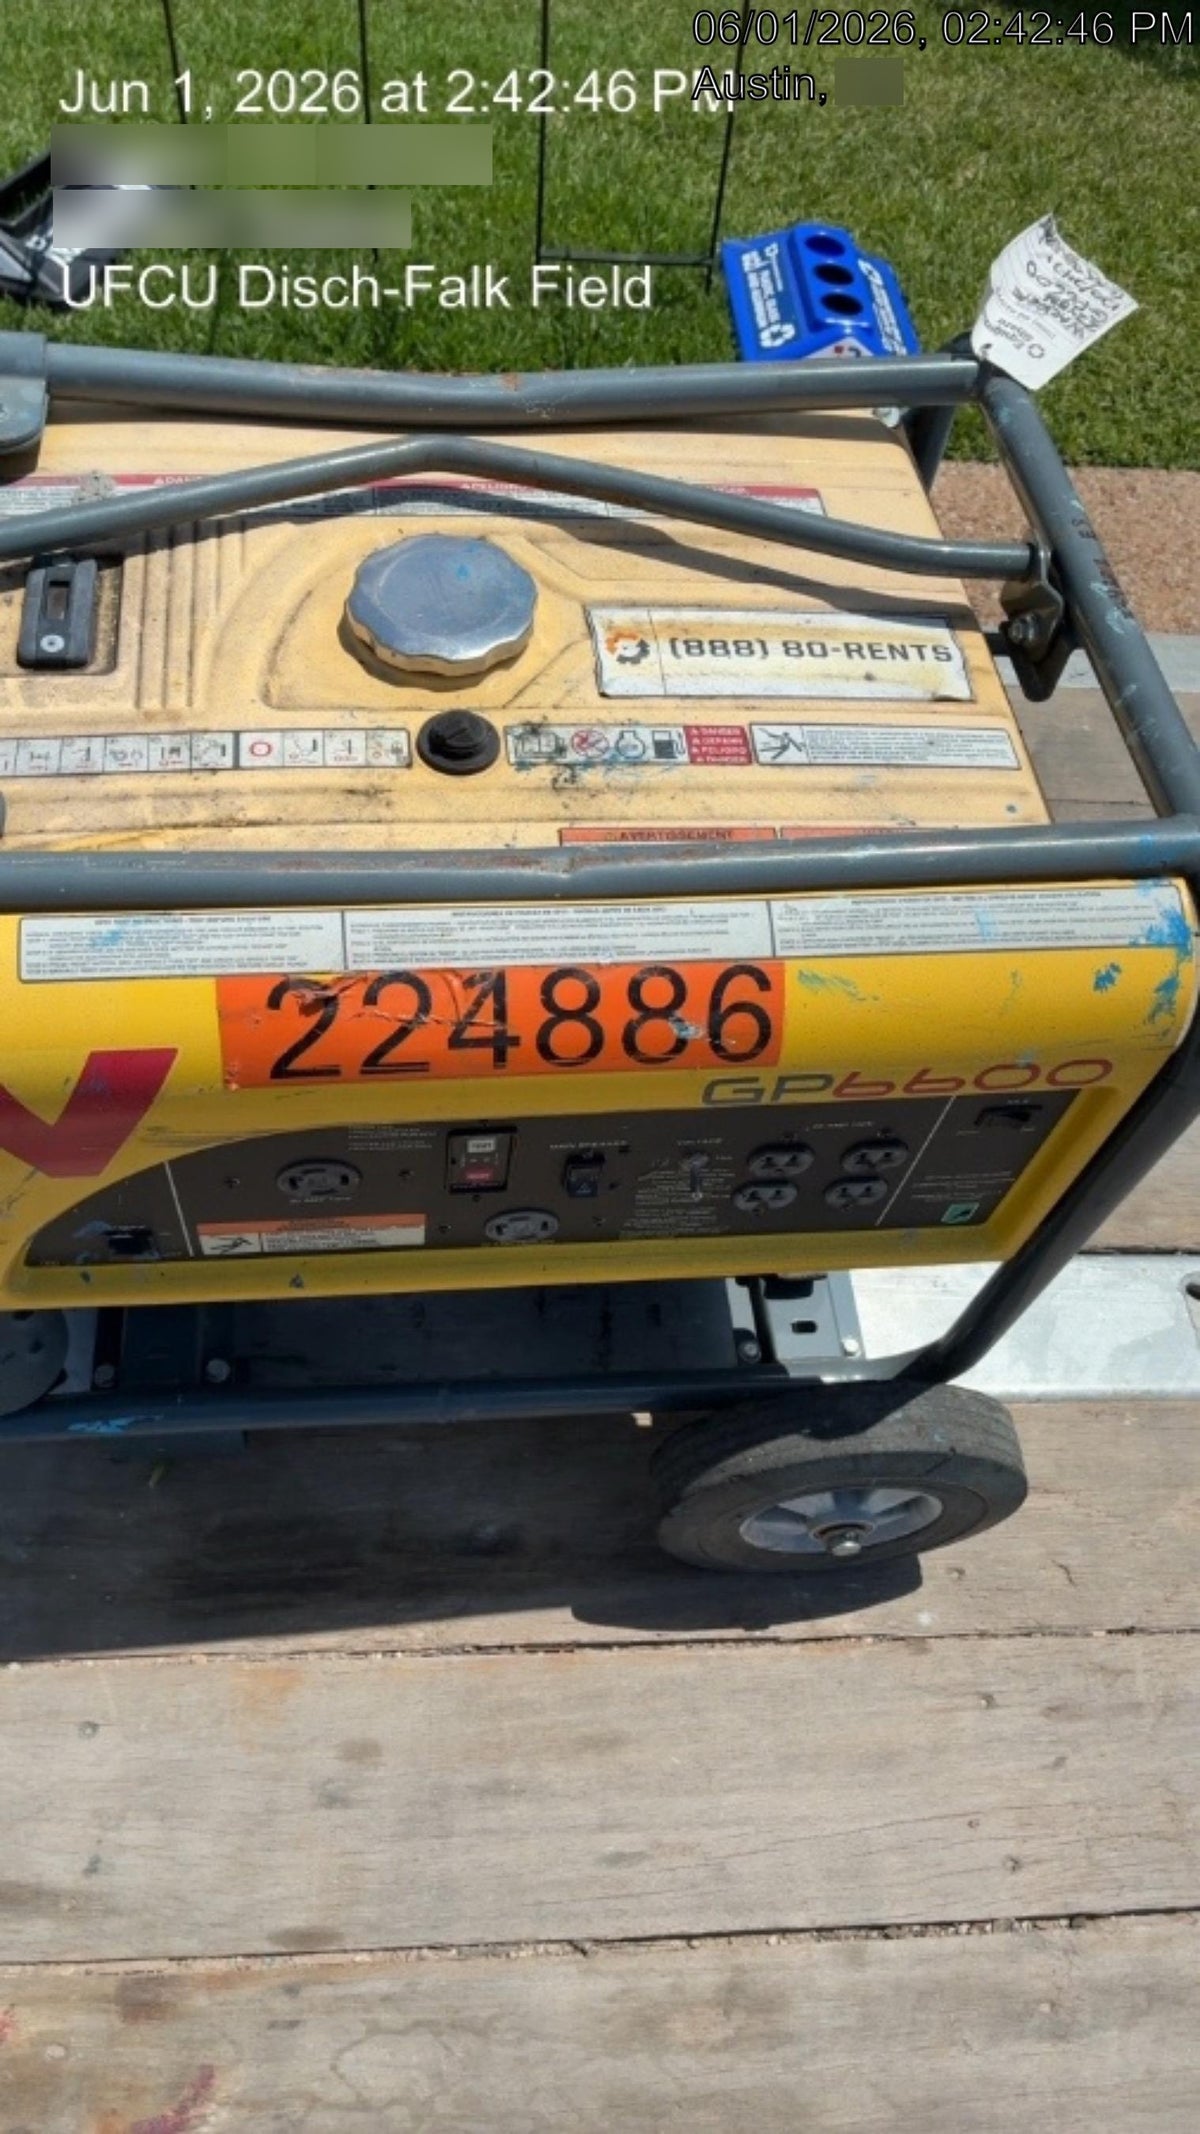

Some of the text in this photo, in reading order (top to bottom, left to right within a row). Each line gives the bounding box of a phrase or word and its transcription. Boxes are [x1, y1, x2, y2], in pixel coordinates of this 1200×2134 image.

[670, 636, 954, 664] (888) 80-RENTS
[265, 963, 774, 1081] 224886
[701, 1057, 1115, 1107] GP6600
